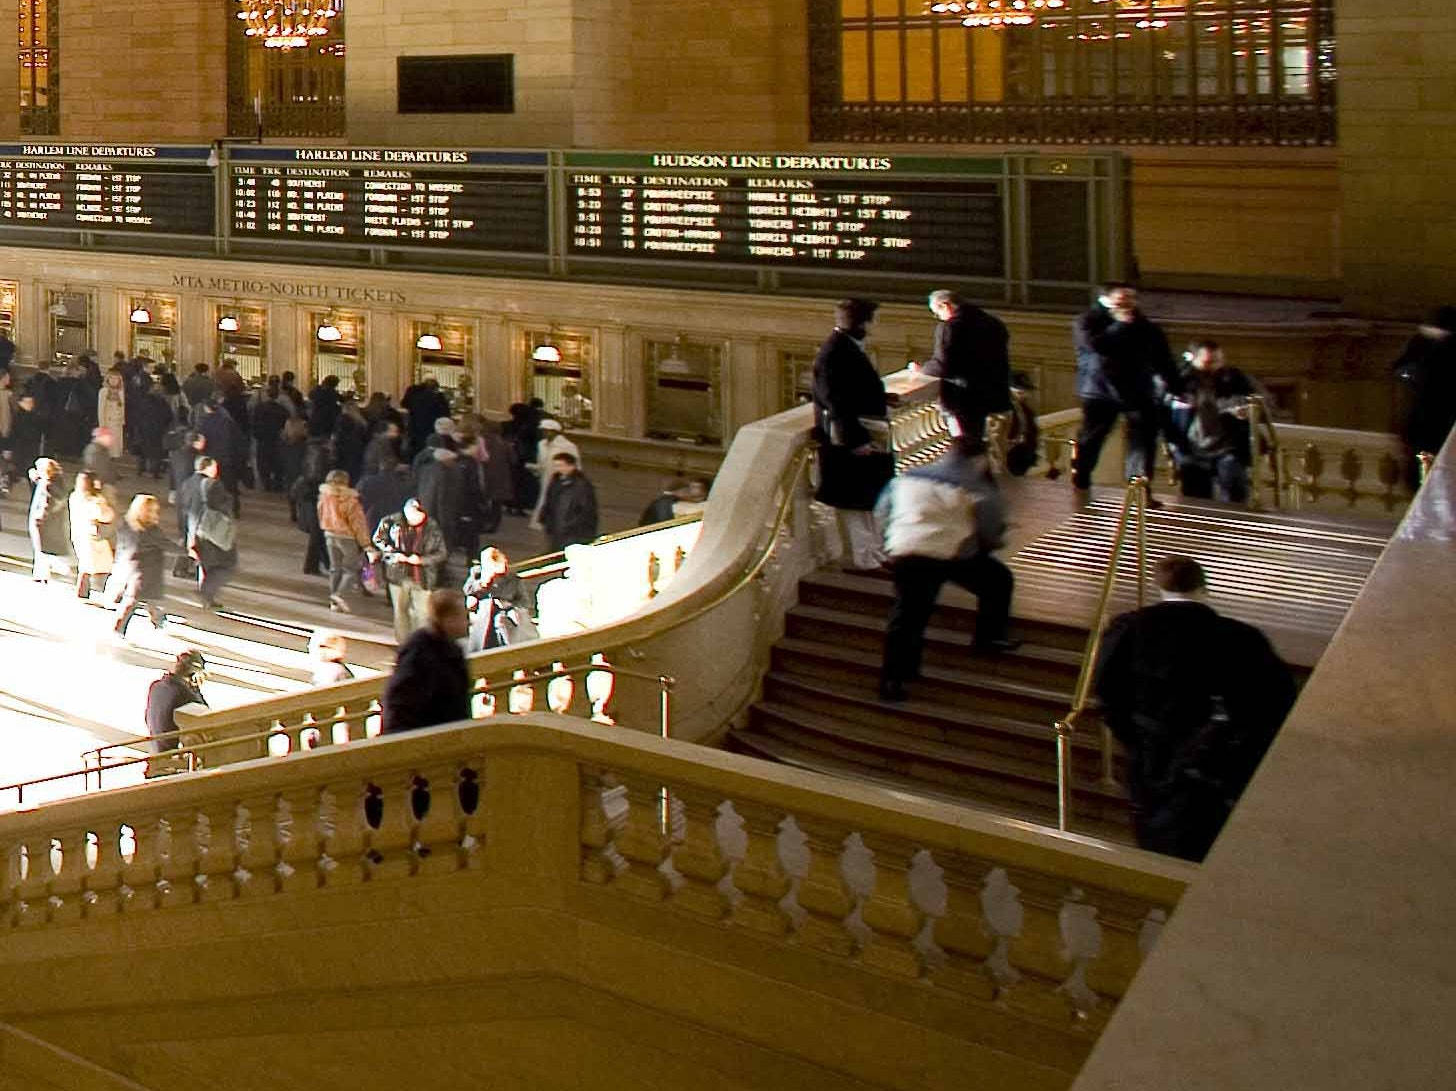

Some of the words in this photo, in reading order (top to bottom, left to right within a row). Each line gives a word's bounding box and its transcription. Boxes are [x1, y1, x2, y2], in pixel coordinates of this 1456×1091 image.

[23, 145, 63, 156] HARLEM
[66, 146, 88, 156] LINE
[91, 147, 156, 157] DEPARTURES
[296, 149, 347, 160] HARLEM
[351, 151, 381, 161] LINE
[384, 151, 468, 163] DEPARTURES
[16, 162, 65, 170] DESTINATION
[653, 154, 727, 168] HUDSON
[730, 156, 772, 169] LINE
[775, 156, 892, 170] DEPARTURES
[263, 167, 281, 175] TRK
[286, 168, 350, 177] DESTINATION
[364, 170, 412, 178] REMARKS
[415, 182, 425, 191] TO
[573, 174, 601, 183] TIME
[608, 175, 637, 184] TRK
[643, 176, 729, 187] DESTINATION
[747, 179, 814, 189] REMARKS
[411, 194, 426, 203] 1ST
[428, 195, 449, 204] STOP
[643, 189, 715, 200] POUGHKEEPSIE
[837, 194, 857, 204] 1ST
[860, 195, 892, 205] STOP
[411, 206, 426, 215] 1ST
[428, 206, 449, 216] STOP
[857, 209, 877, 219] 1ST
[882, 209, 912, 220] STOP
[434, 219, 449, 228] 1ST
[452, 219, 474, 228] STOP
[643, 215, 716, 226] POUGHKEEPSIE
[812, 221, 832, 231] 1ST
[835, 222, 866, 232] STOP
[428, 230, 449, 239] STOP
[857, 237, 877, 247] 1ST
[882, 237, 912, 248] STOP
[812, 249, 832, 259] 1ST
[836, 250, 866, 260] STOP
[172, 275, 203, 289] MTA
[209, 277, 329, 298] METRO-NORTH
[335, 287, 406, 304] TICKETS
